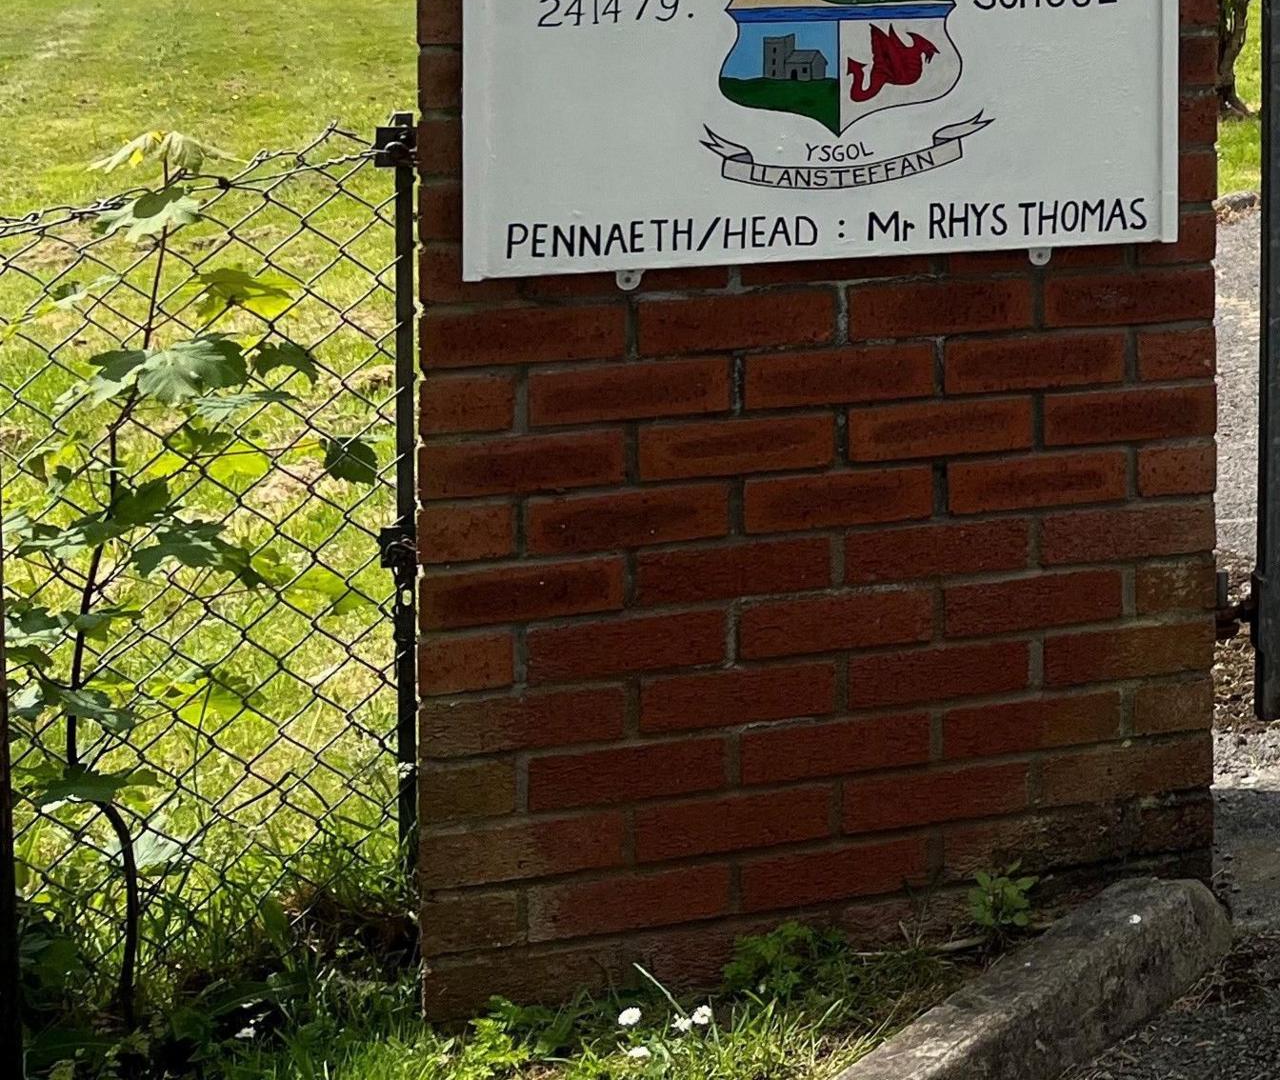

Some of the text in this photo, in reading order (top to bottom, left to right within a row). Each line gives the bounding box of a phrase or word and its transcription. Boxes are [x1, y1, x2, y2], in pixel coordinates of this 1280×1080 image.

[750, 150, 935, 188] LLANSTEFFAN
[804, 141, 874, 163] YSGOL
[506, 215, 819, 259] PENNAETH/HEAD
[867, 210, 916, 242] Mr
[929, 203, 1007, 240] RHYS
[1018, 197, 1148, 235] THOMAS
